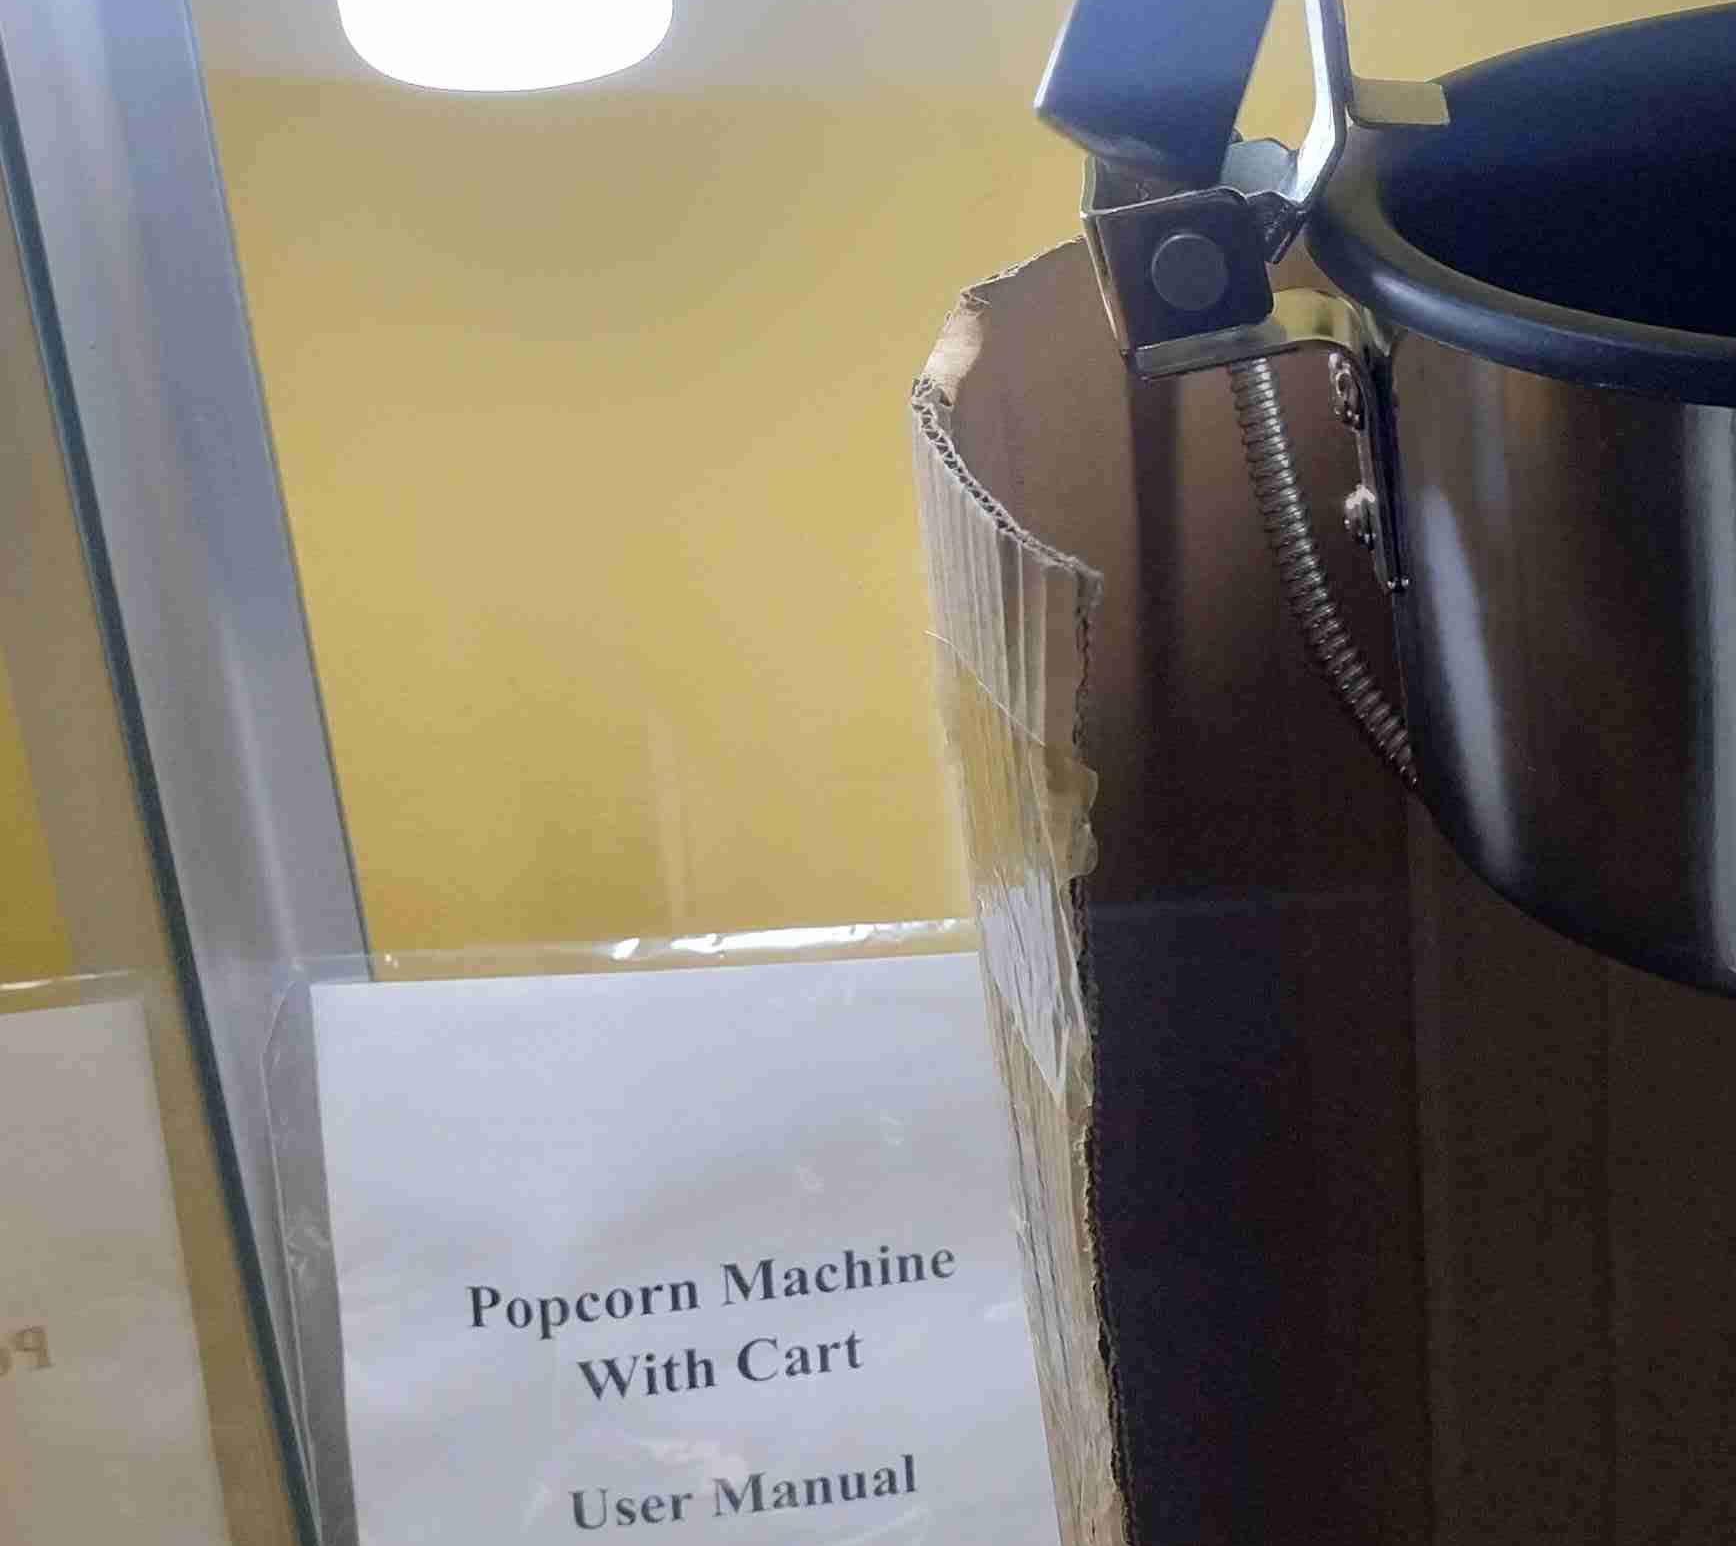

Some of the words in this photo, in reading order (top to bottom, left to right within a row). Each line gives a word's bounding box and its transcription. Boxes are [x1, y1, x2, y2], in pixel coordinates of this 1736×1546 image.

[465, 1279, 699, 1340] Popcorn
[720, 1244, 957, 1305] Machine
[577, 1348, 718, 1401] With
[736, 1329, 864, 1383] Cart
[568, 1487, 694, 1531] User
[712, 1453, 918, 1517] Manual
